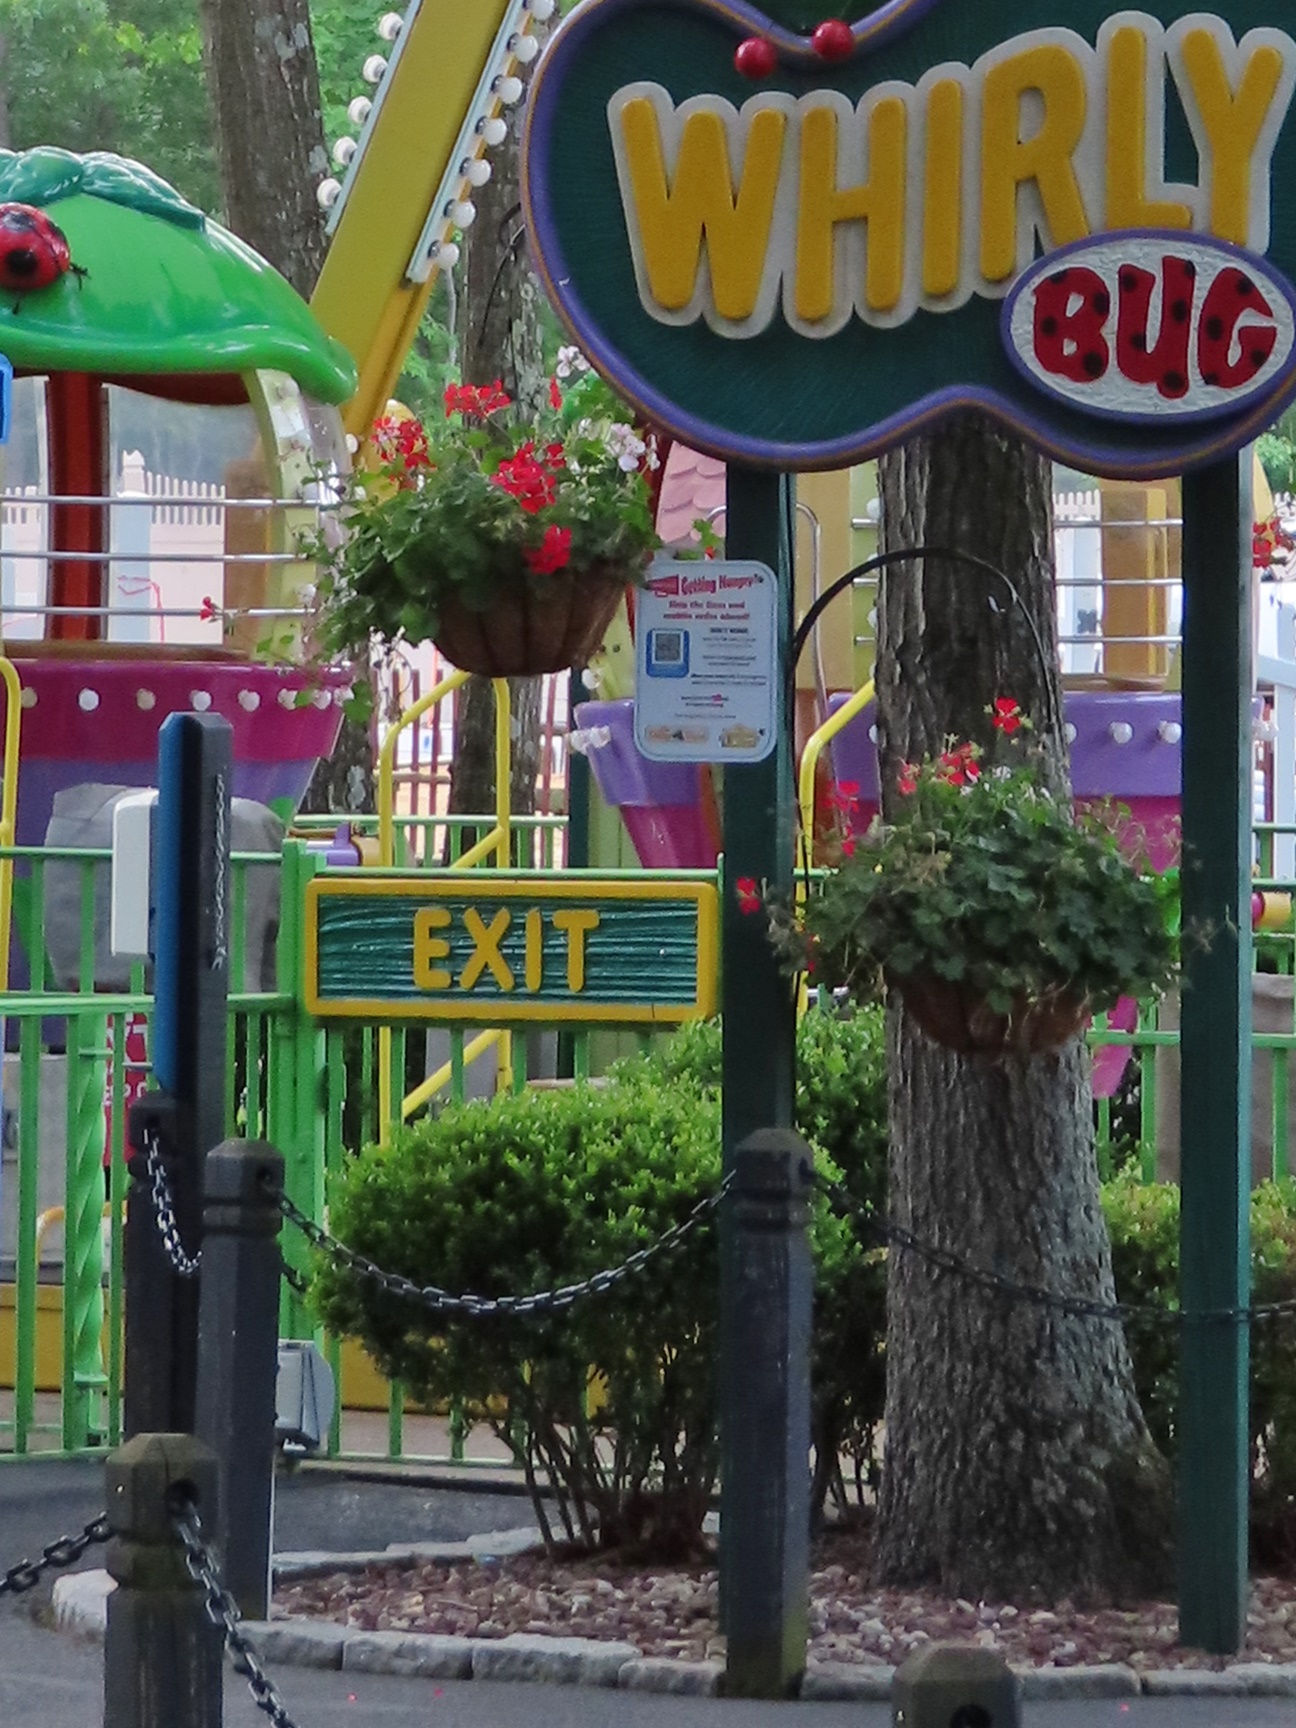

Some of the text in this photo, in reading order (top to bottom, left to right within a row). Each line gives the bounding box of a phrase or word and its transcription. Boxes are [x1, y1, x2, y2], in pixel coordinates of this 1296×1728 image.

[612, 17, 1292, 332] WHIRLY
[1031, 256, 1278, 400] BUG
[413, 907, 600, 993] EXIT
